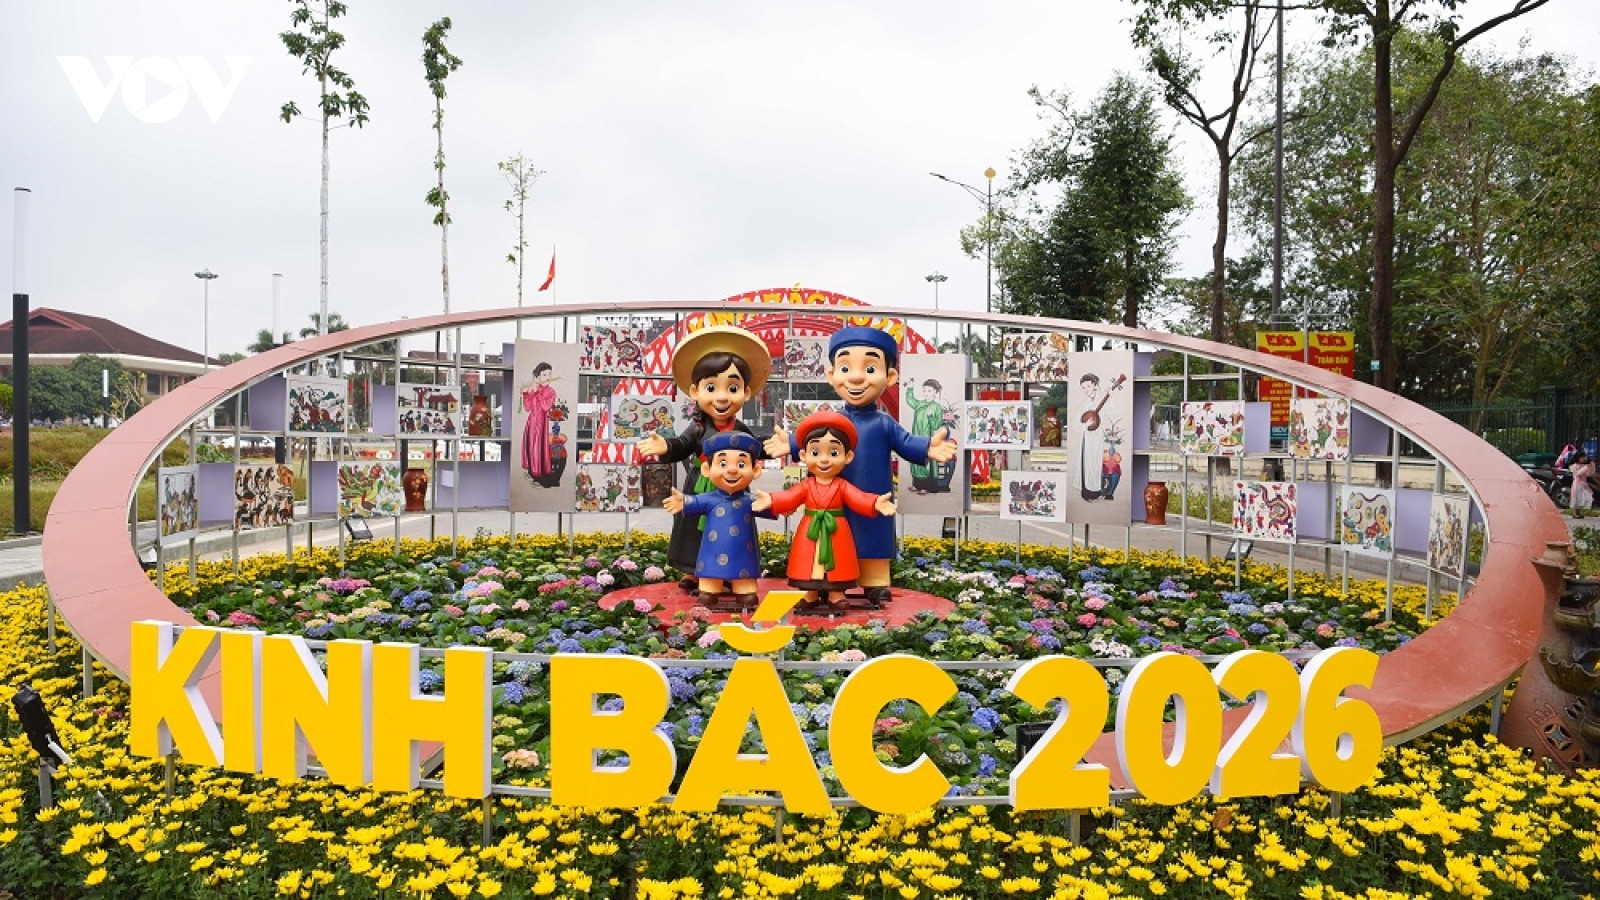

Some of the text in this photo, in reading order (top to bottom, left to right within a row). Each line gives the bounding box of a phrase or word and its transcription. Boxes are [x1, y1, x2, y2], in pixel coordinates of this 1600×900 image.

[130, 590, 1383, 814] KINH BẮC 2026
